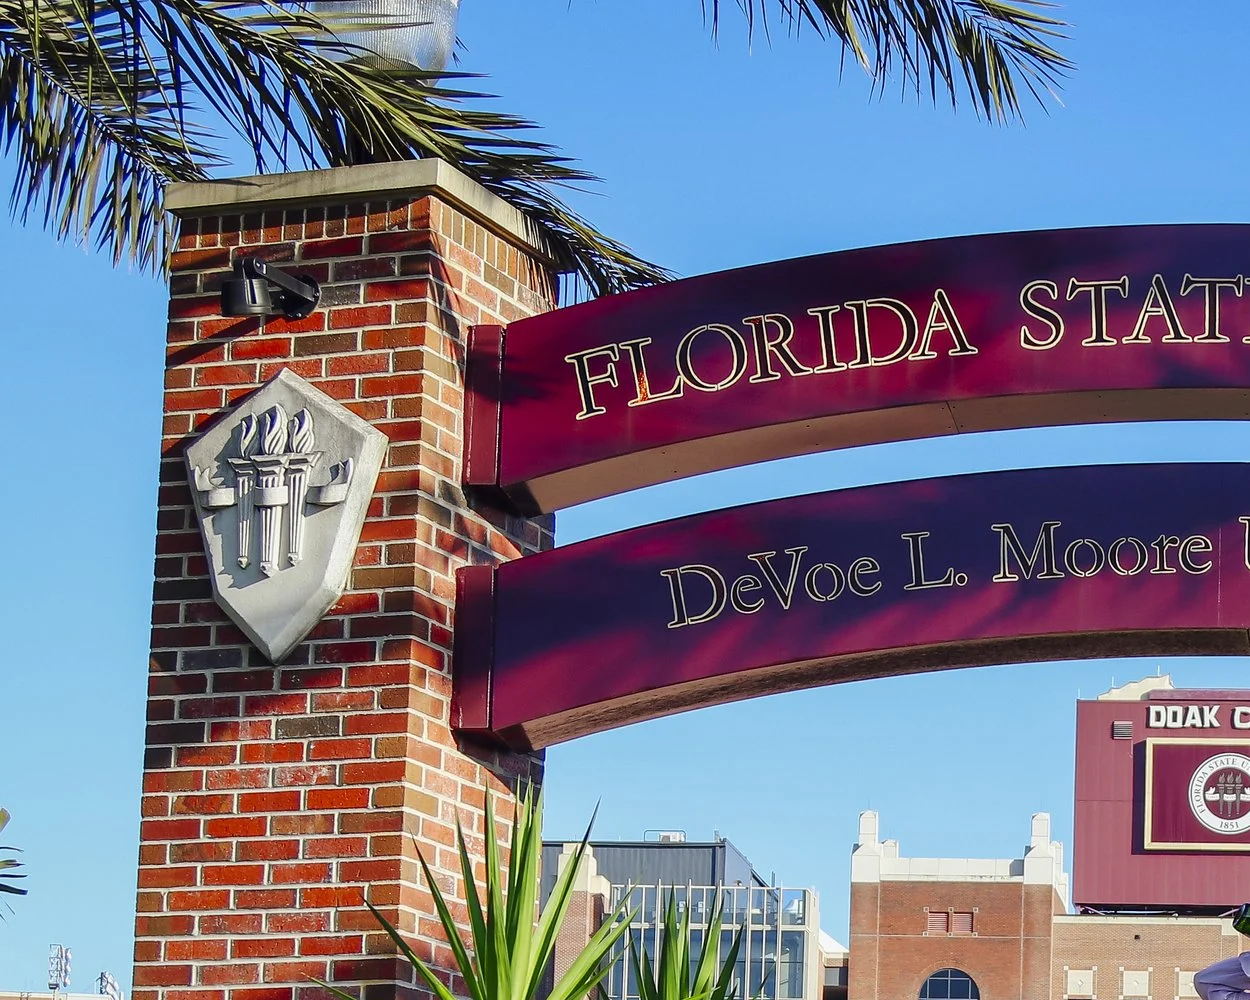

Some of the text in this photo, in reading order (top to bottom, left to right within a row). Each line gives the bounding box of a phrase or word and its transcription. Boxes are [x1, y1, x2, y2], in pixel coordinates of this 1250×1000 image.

[565, 287, 978, 421] FLORIDA
[659, 545, 882, 629] DeVoe
[900, 531, 968, 591] L.
[990, 520, 1213, 583] Moore
[1149, 705, 1221, 729] DOAK
[1194, 771, 1208, 814] FLORIDA
[1208, 758, 1238, 770] STATE
[1220, 821, 1239, 829] 1851
